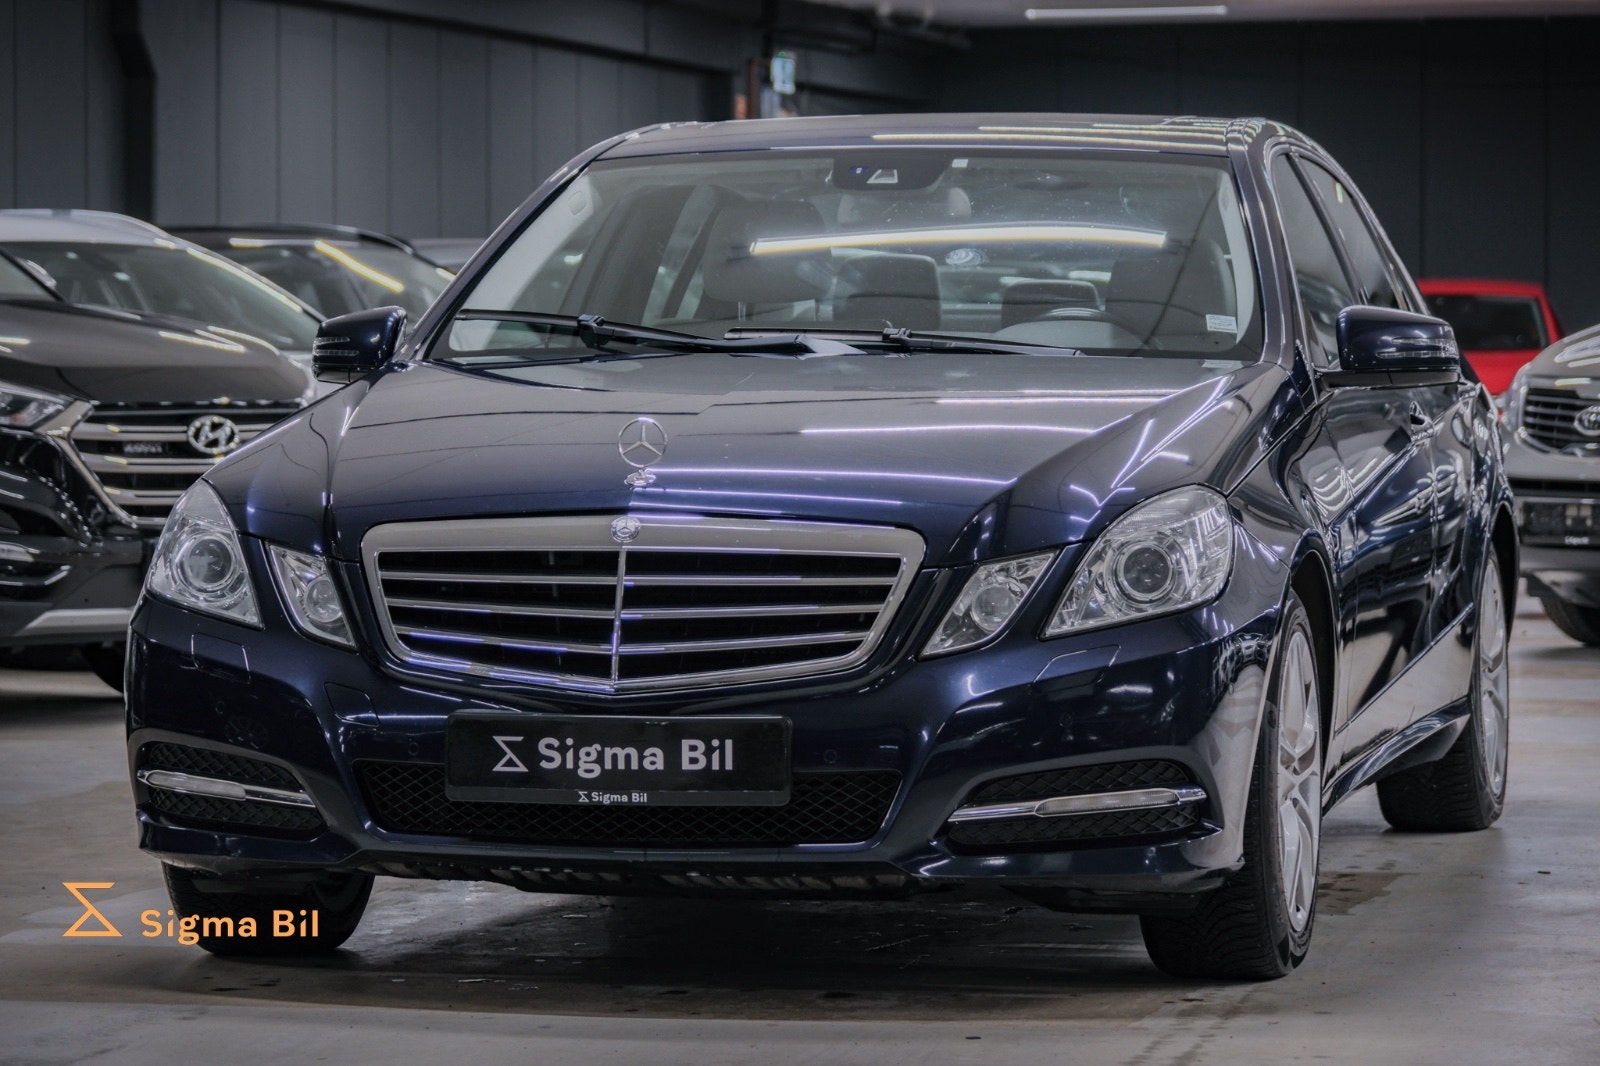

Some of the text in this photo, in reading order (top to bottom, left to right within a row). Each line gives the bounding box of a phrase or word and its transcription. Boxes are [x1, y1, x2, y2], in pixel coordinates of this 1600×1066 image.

[538, 737, 733, 779] Sigma Bil
[591, 791, 648, 805] Sigma Bil
